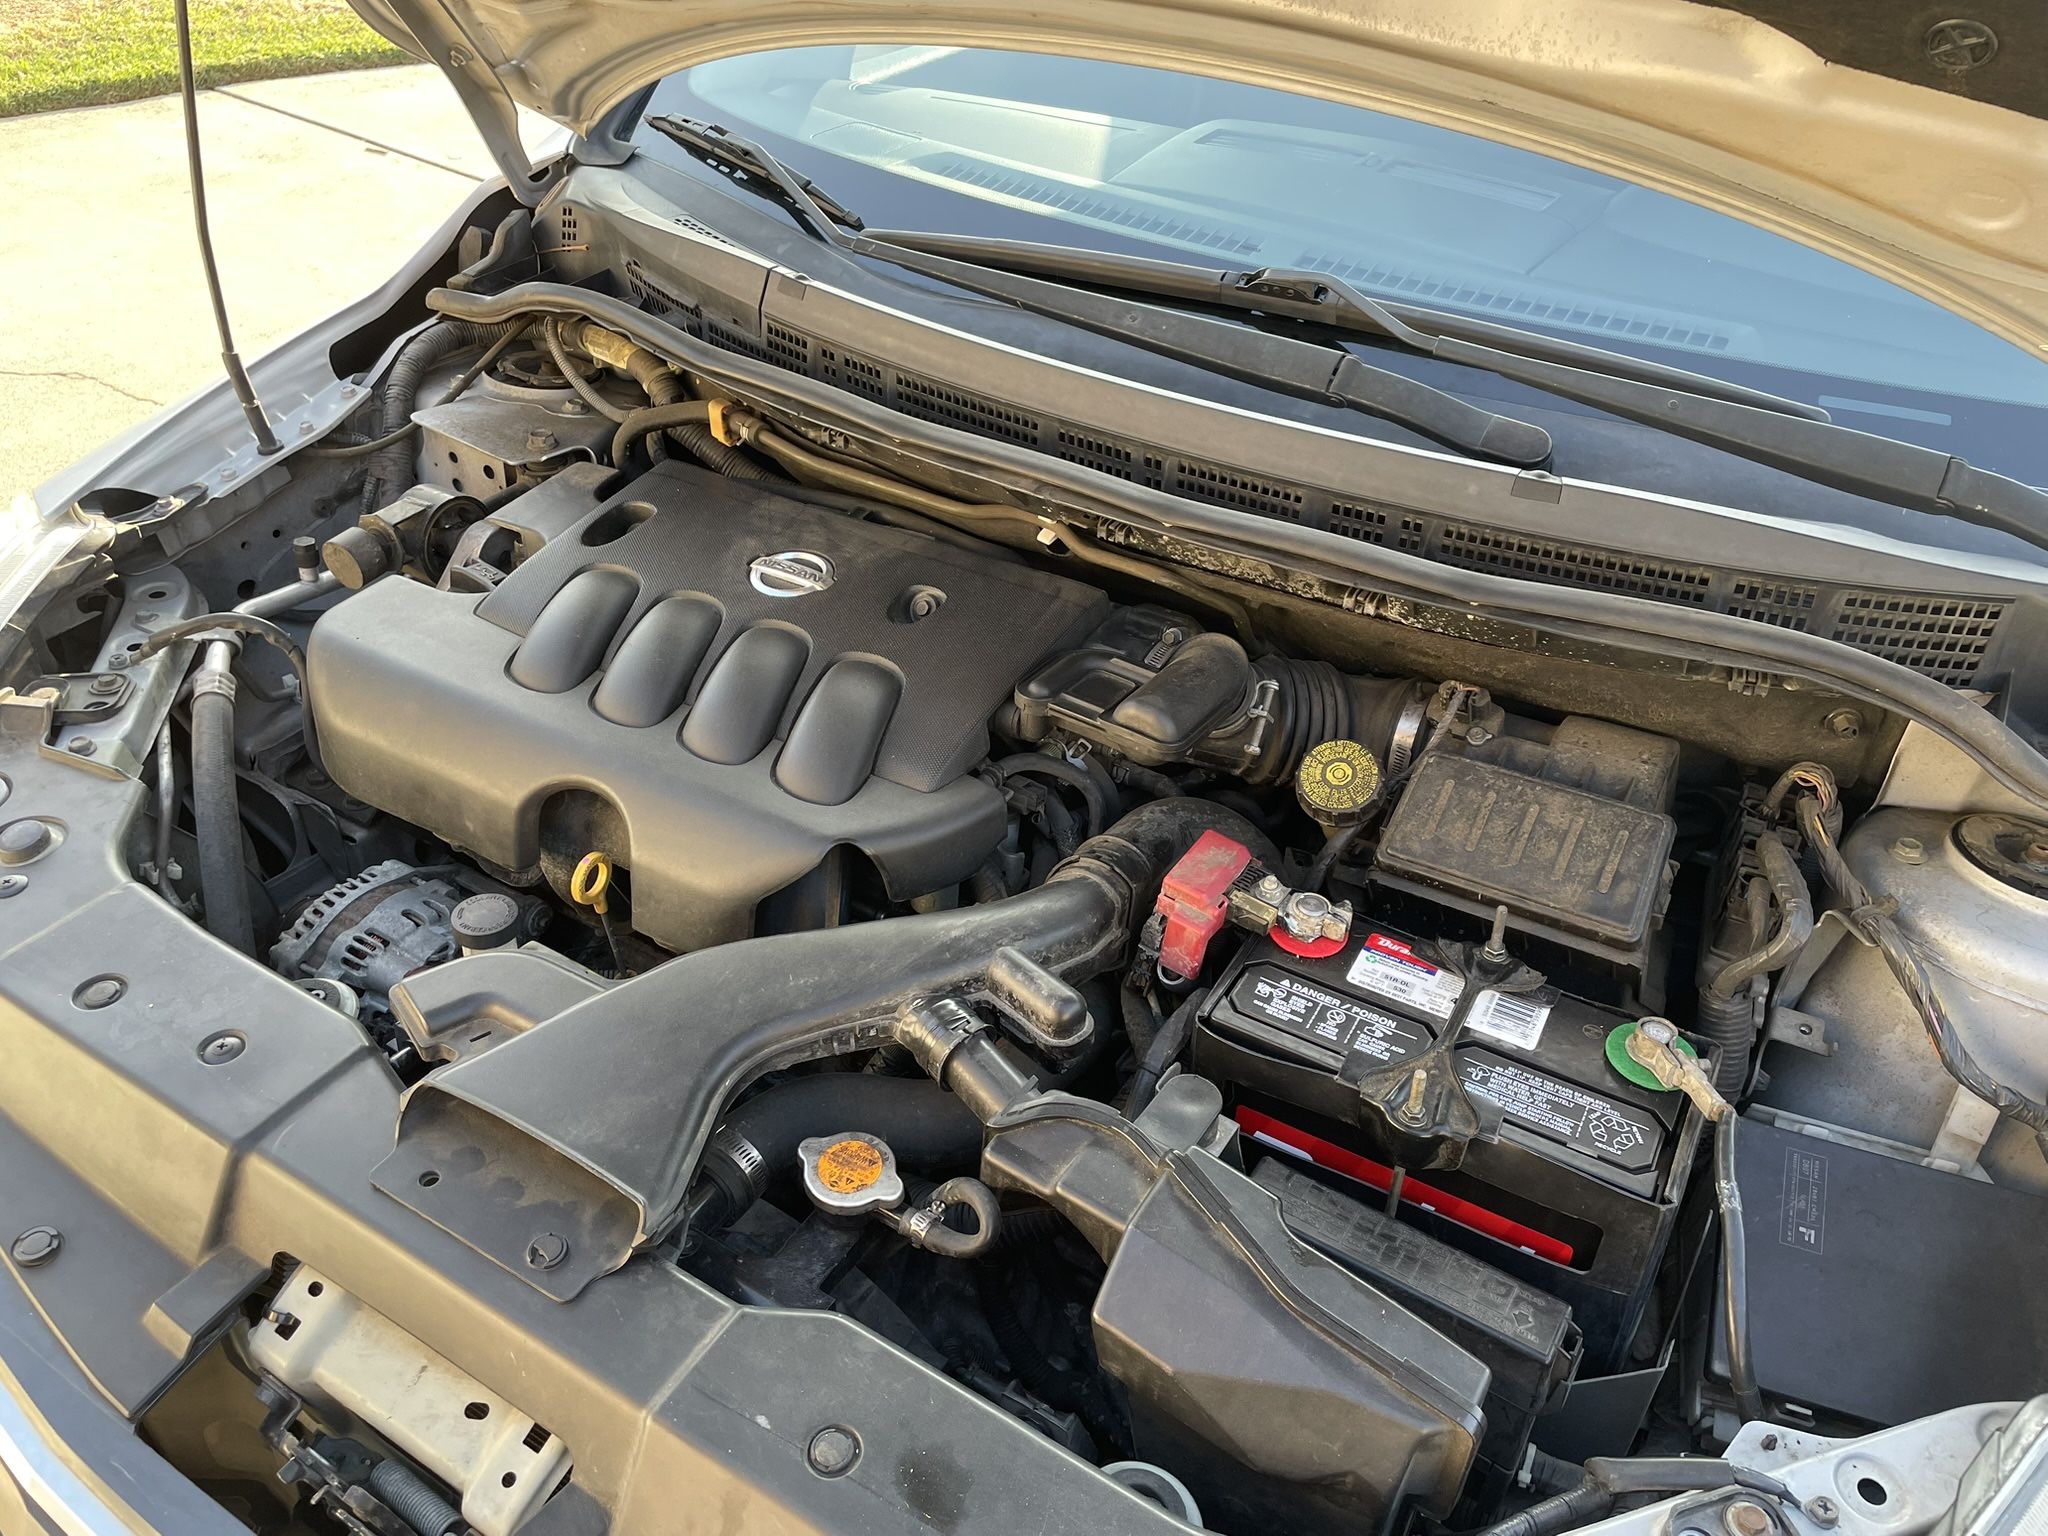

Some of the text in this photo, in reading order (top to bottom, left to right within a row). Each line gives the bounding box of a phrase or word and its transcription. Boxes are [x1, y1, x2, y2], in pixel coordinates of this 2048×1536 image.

[760, 559, 821, 582] NISSAN
[1378, 938, 1411, 956] Dura
[1392, 985, 1406, 994] 530
[1270, 1001, 1291, 1012] GASES
[1272, 997, 1306, 1014] EXPLOSIVE
[1288, 999, 1305, 1008] EYES
[1290, 995, 1313, 1007] SHIELD
[1292, 983, 1342, 1008] DANGER
[1351, 1006, 1397, 1028] POISON
[1359, 1033, 1405, 1054] SULFURIC ACID
[1486, 1082, 1551, 1110] MEDICAL HELP FAST
[1488, 1077, 1507, 1088] WITH
[1533, 1094, 1546, 1103] GET
[1490, 1072, 1574, 1108] FLUSH EYES IMMEDIATELY
[1594, 1141, 1622, 1155] RECYCLE
